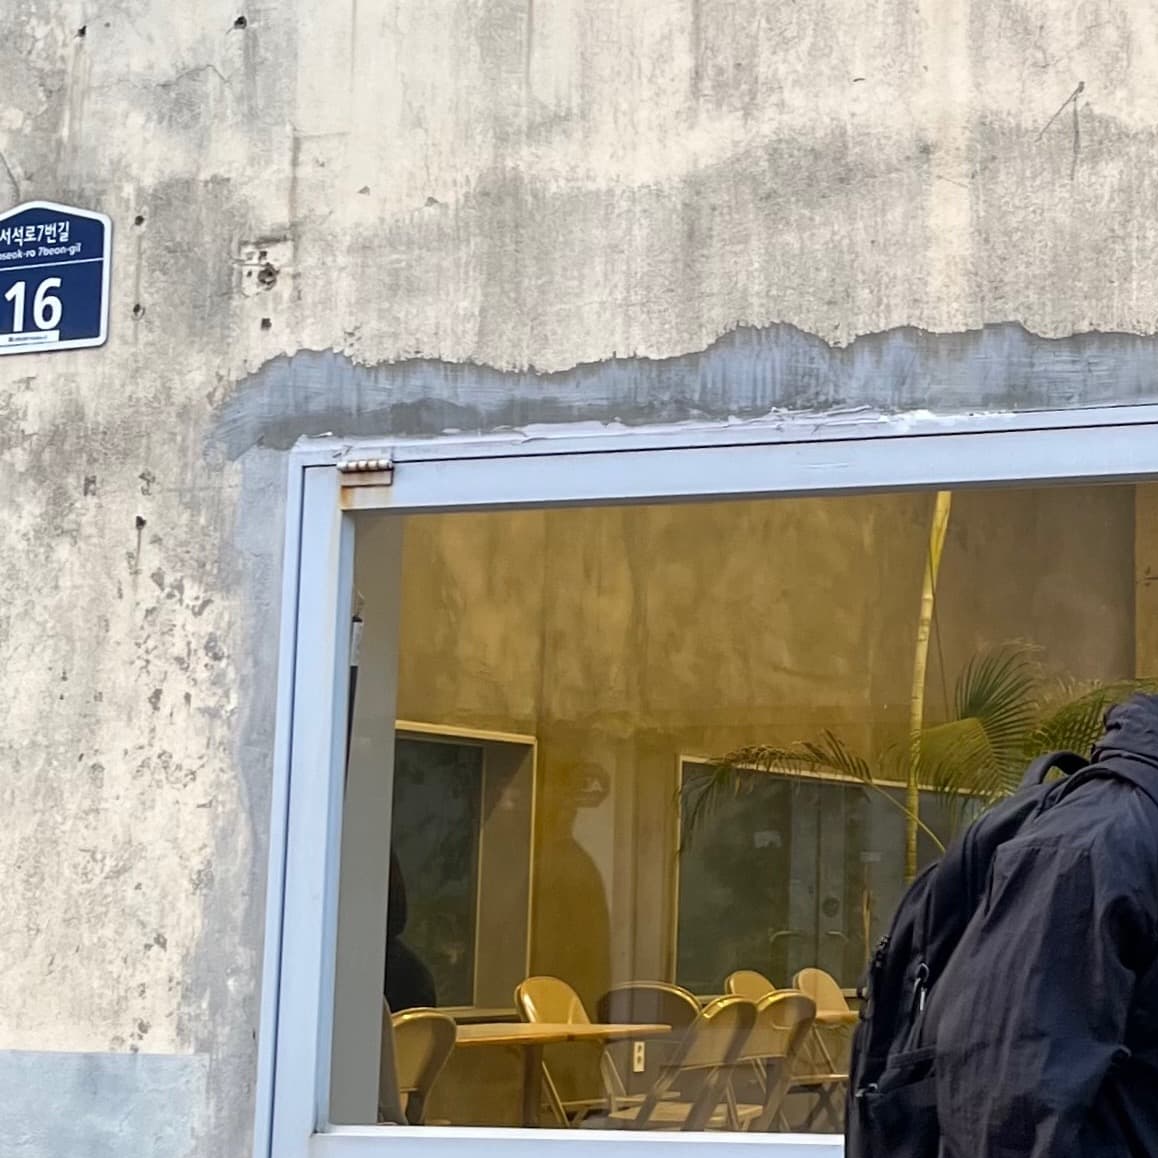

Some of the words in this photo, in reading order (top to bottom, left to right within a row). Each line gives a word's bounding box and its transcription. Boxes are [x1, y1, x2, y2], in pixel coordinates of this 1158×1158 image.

[0, 221, 70, 247] 서석로7번길
[38, 242, 82, 256] 7beon-gil
[4, 277, 62, 332] 16
